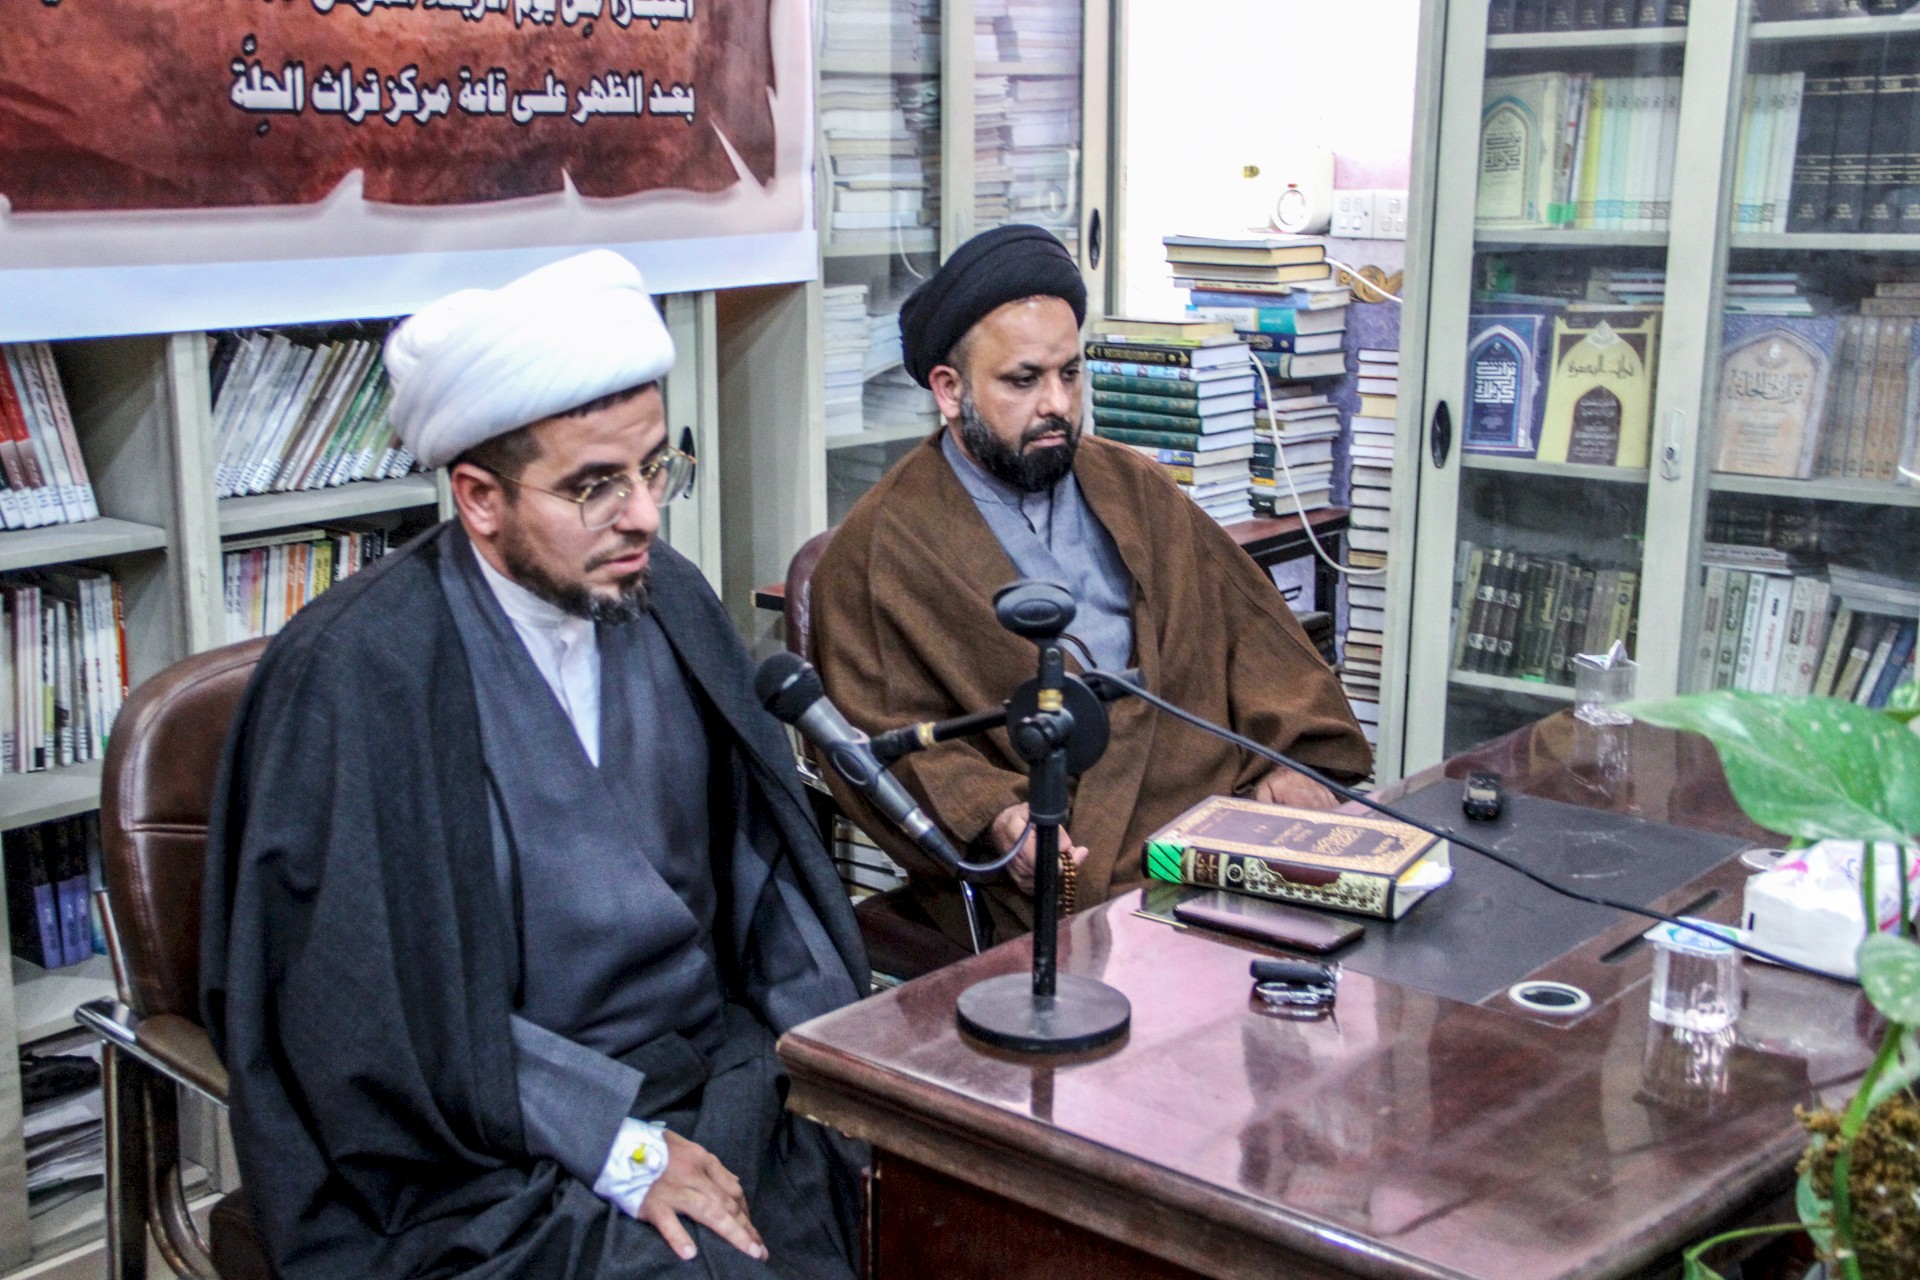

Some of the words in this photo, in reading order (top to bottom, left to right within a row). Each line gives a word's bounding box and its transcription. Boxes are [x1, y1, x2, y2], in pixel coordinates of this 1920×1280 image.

[311, 65, 381, 124] تراث
[383, 65, 452, 124] مركز
[457, 67, 507, 114] قاعة
[511, 70, 568, 124] على
[571, 70, 643, 124] الظهر
[648, 82, 696, 123] بعد
